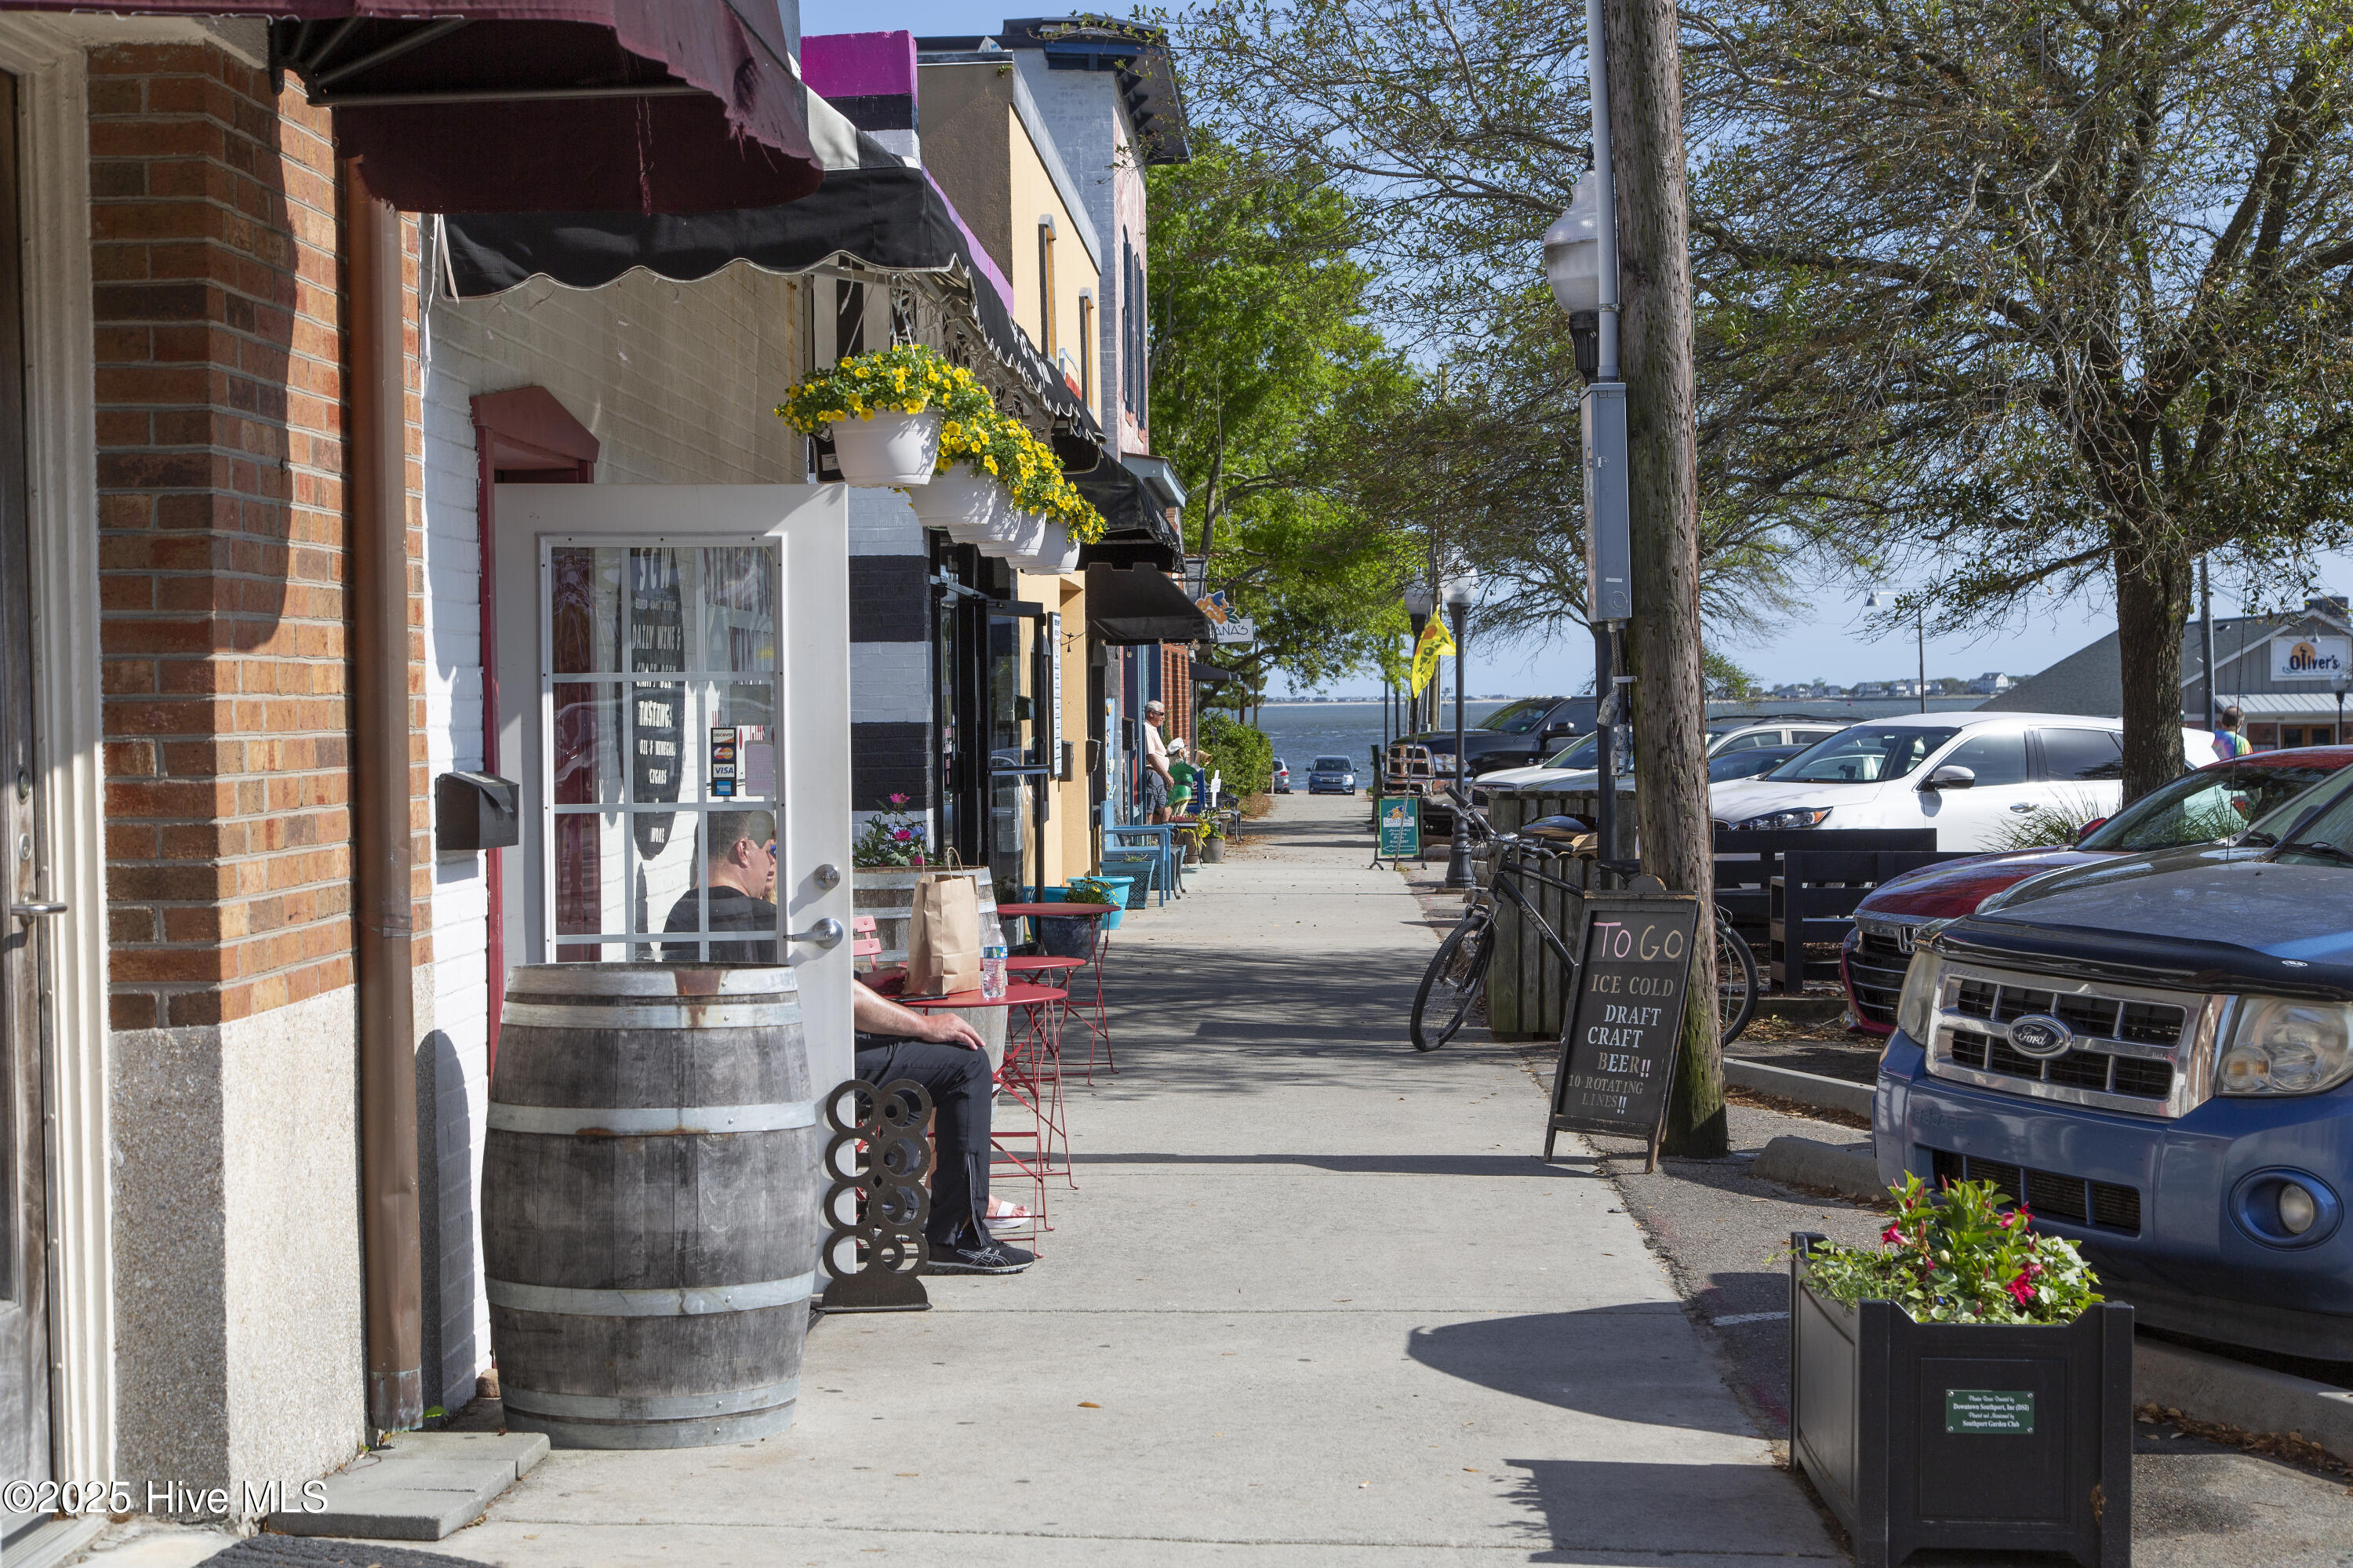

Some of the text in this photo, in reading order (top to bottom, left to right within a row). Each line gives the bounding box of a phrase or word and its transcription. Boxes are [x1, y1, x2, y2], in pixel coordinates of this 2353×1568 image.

[632, 624, 654, 649] DAILY
[657, 625, 675, 650] WINE
[2289, 652, 2339, 671] Oliver's
[638, 700, 673, 728] TASTINGS
[639, 739, 648, 755] OIL
[649, 769, 667, 784] CIGARS
[650, 828, 665, 843] MORE
[1640, 925, 1683, 961] GO
[1591, 974, 1675, 997] ICE COLD
[1604, 1004, 1662, 1026] DRAFT
[1587, 1026, 1643, 1049] CRAFT
[2018, 1024, 2048, 1046] Ford
[1598, 1053, 1650, 1078] BEER!!
[1584, 1075, 1644, 1095] ROTATING
[1581, 1092, 1627, 1115] LINES!!
[1980, 1403, 2006, 1412] Southport,
